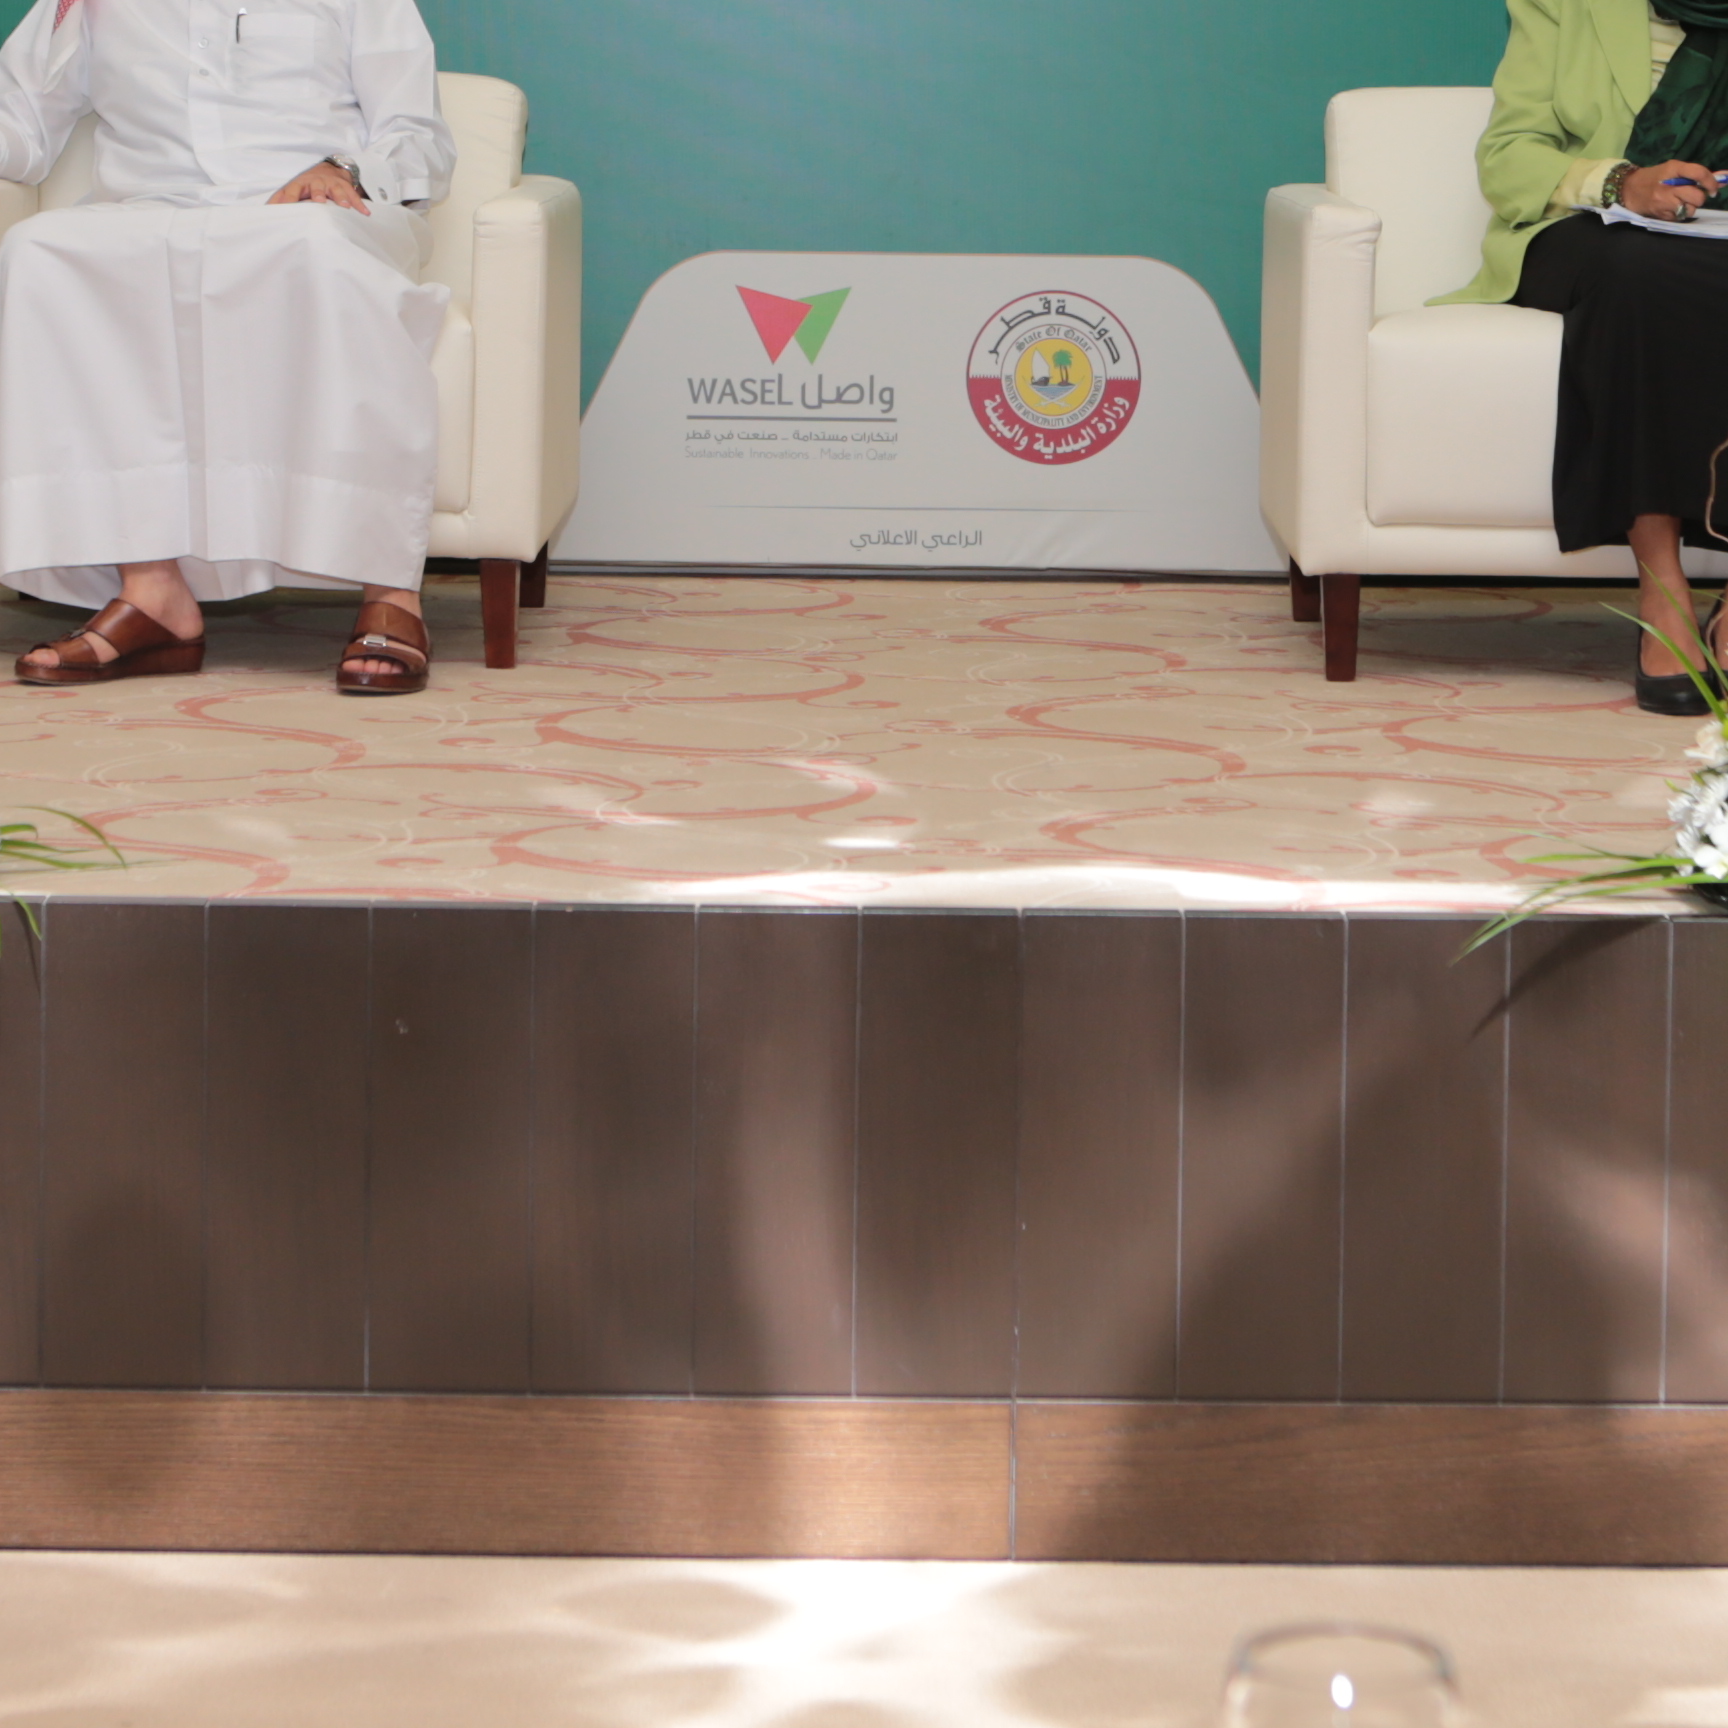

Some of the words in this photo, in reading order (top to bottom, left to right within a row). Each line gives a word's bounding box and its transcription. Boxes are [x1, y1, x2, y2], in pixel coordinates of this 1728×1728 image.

[1015, 330, 1043, 353] State
[1064, 329, 1093, 353] Qatar
[687, 372, 794, 406] WASEL
[800, 373, 895, 414] واصل
[684, 446, 745, 460] Sustainable
[749, 447, 810, 461] Innovations
[820, 448, 851, 461] Made
[853, 449, 863, 461] in
[866, 448, 898, 462] Qatar
